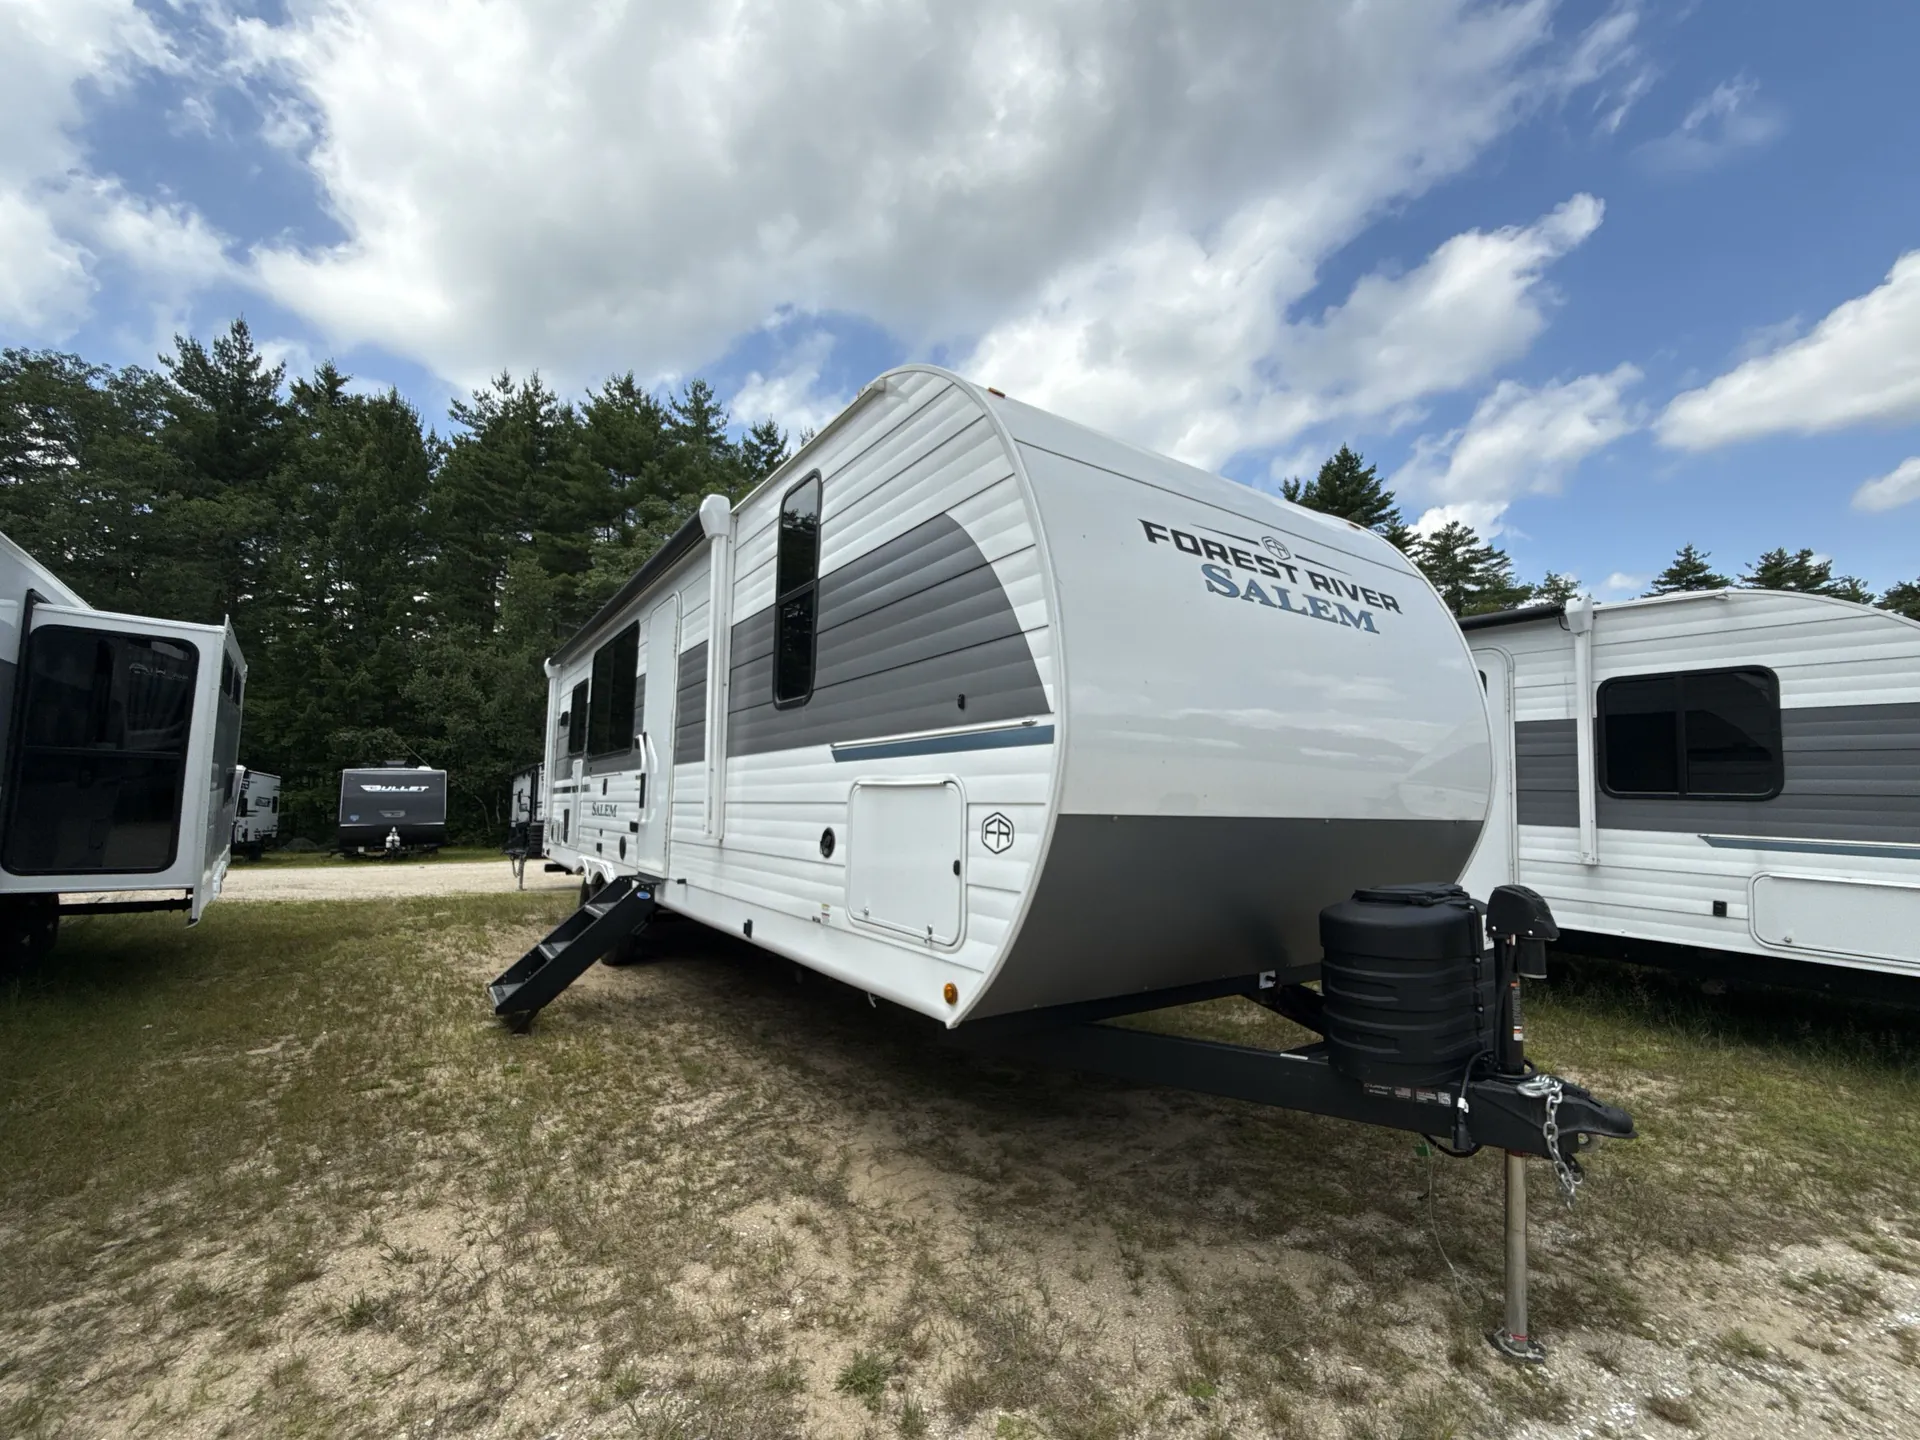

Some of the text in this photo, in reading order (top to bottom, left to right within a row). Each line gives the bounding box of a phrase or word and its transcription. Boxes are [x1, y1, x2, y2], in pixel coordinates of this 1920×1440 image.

[1137, 518, 1403, 615] FOREST RIVER
[1201, 563, 1380, 635] SALEM
[360, 784, 430, 793] BULLET
[591, 800, 618, 818] SALEM
